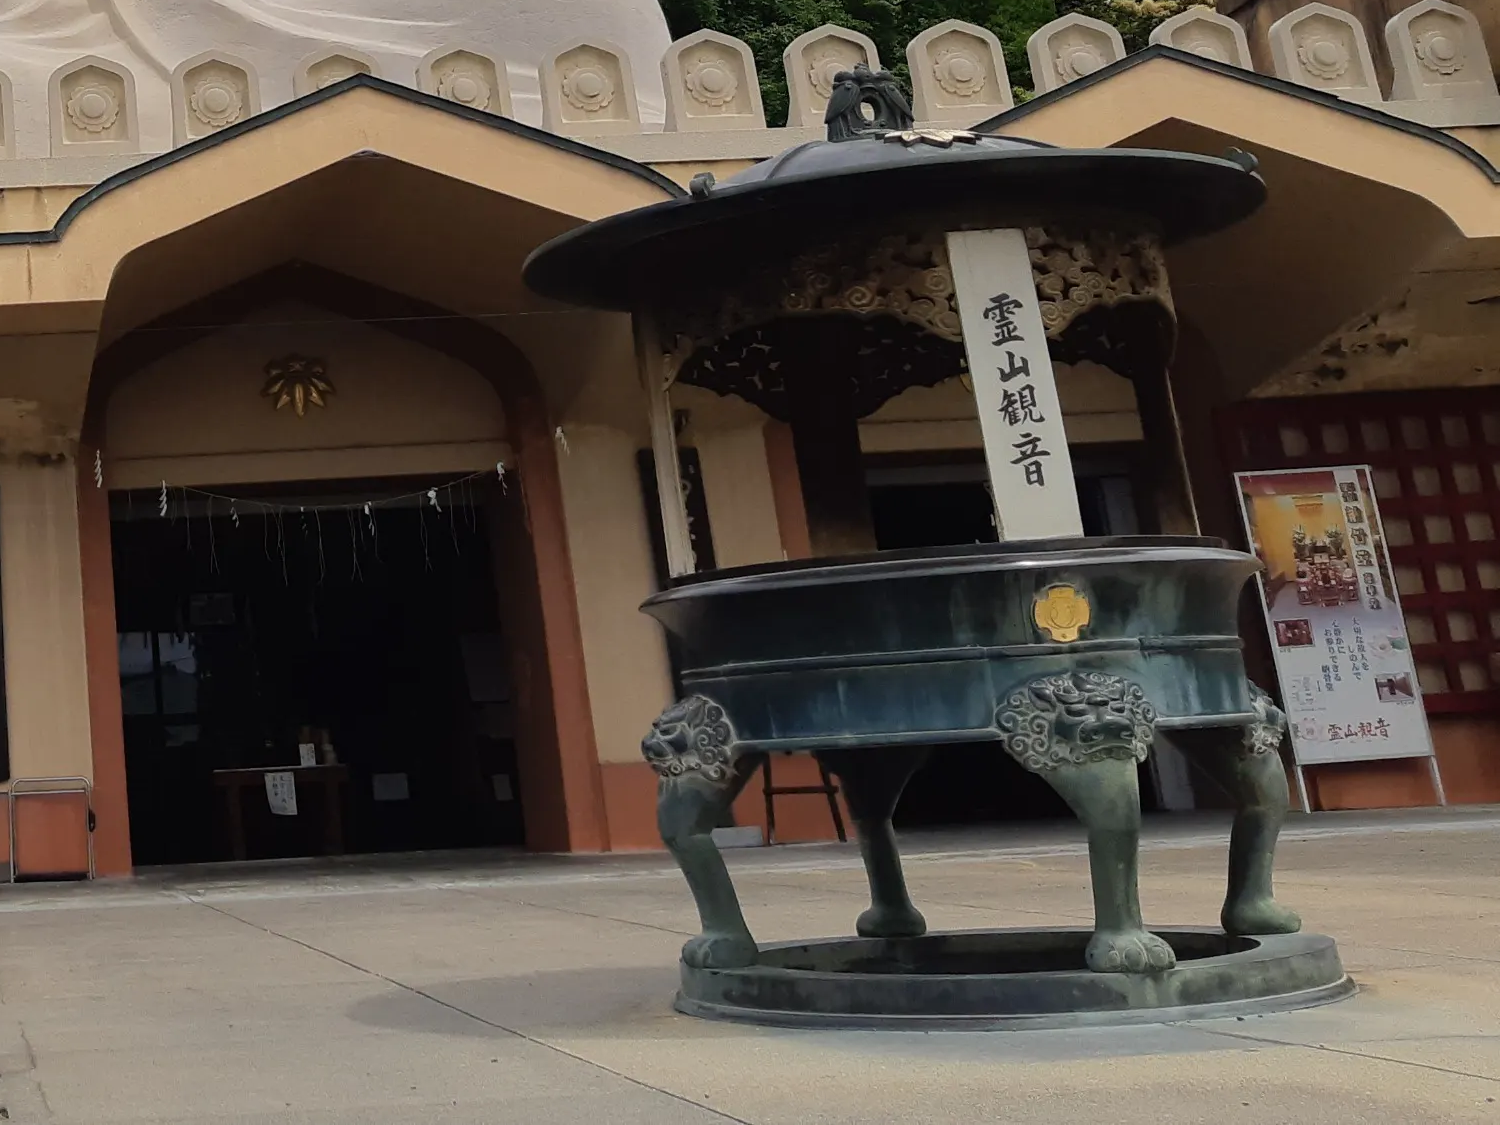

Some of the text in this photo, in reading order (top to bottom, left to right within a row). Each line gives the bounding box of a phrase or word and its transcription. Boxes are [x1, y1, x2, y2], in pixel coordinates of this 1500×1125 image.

[981, 292, 1052, 488] 霊山観音
[1348, 645, 1362, 681] しのんで
[1351, 616, 1370, 671] 大切な故人を
[1327, 717, 1391, 742] 霊山観音
